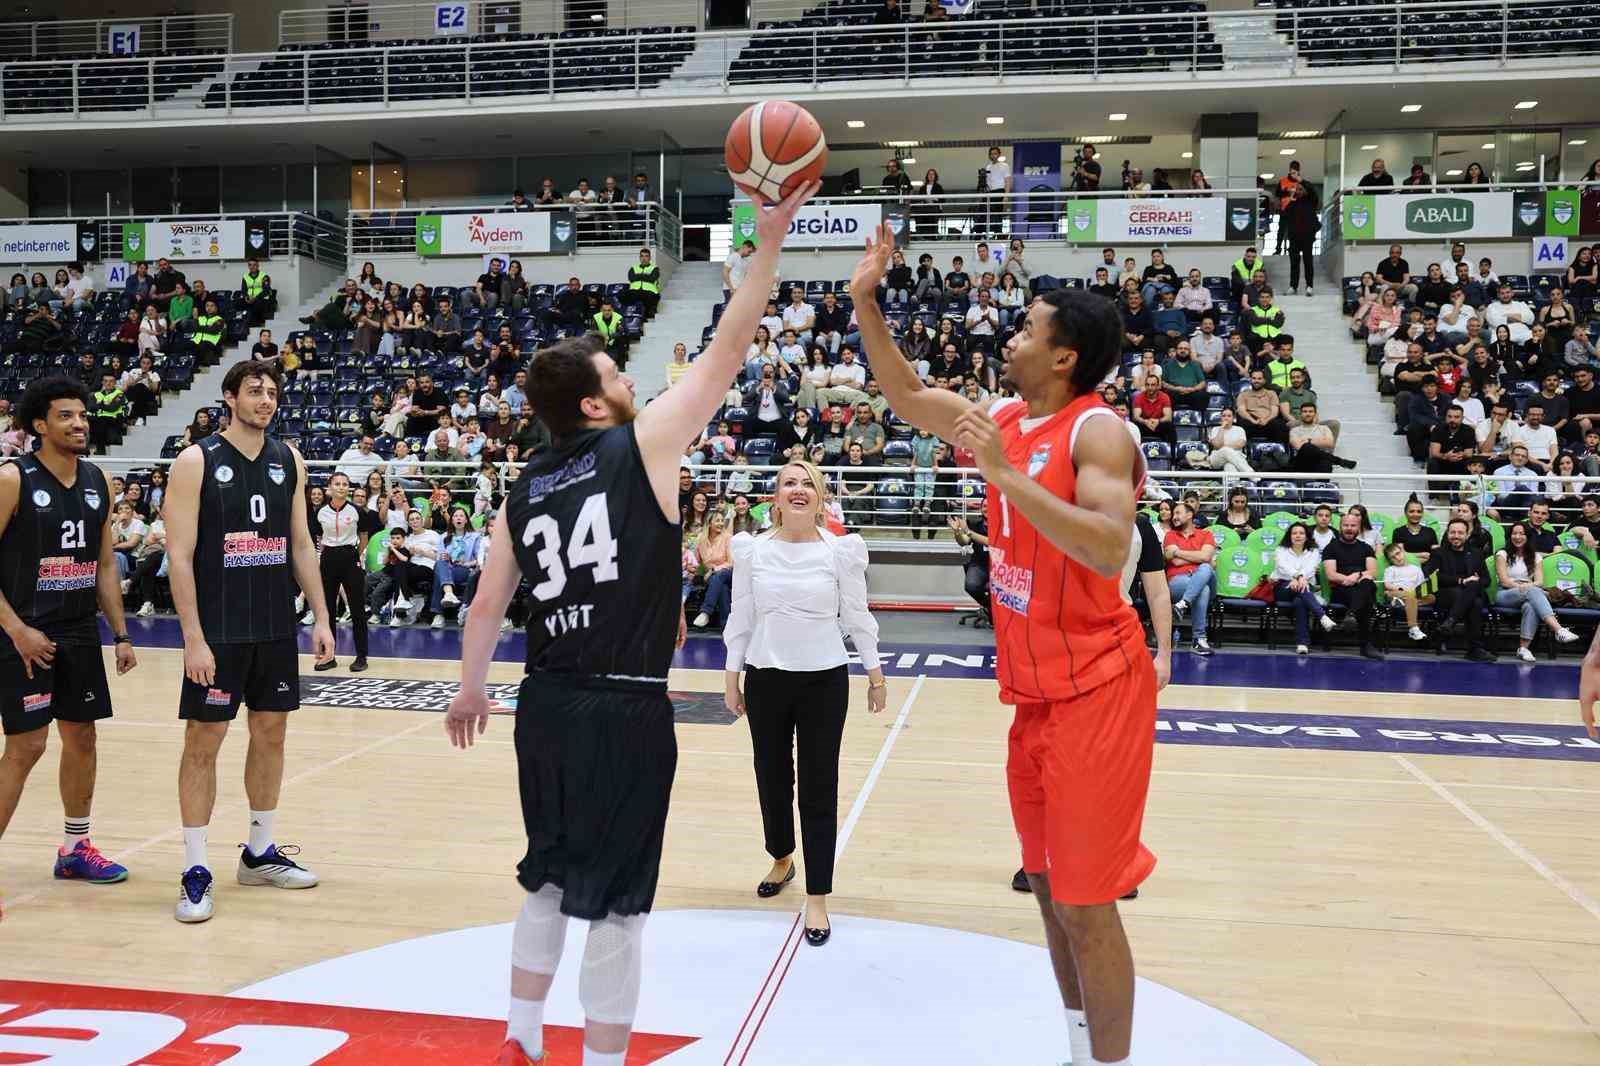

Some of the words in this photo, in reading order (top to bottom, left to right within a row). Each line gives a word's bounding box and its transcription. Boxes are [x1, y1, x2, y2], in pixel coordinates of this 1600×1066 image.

[437, 6, 465, 28] E2
[112, 31, 136, 55] E1
[1412, 207, 1467, 224] ABALI
[4, 239, 70, 252] netinternet
[470, 227, 523, 245] Aydem
[1538, 243, 1564, 261] A4
[110, 266, 126, 283] A1
[250, 494, 267, 524] 0
[61, 520, 87, 549] 21
[522, 491, 619, 601] 34
